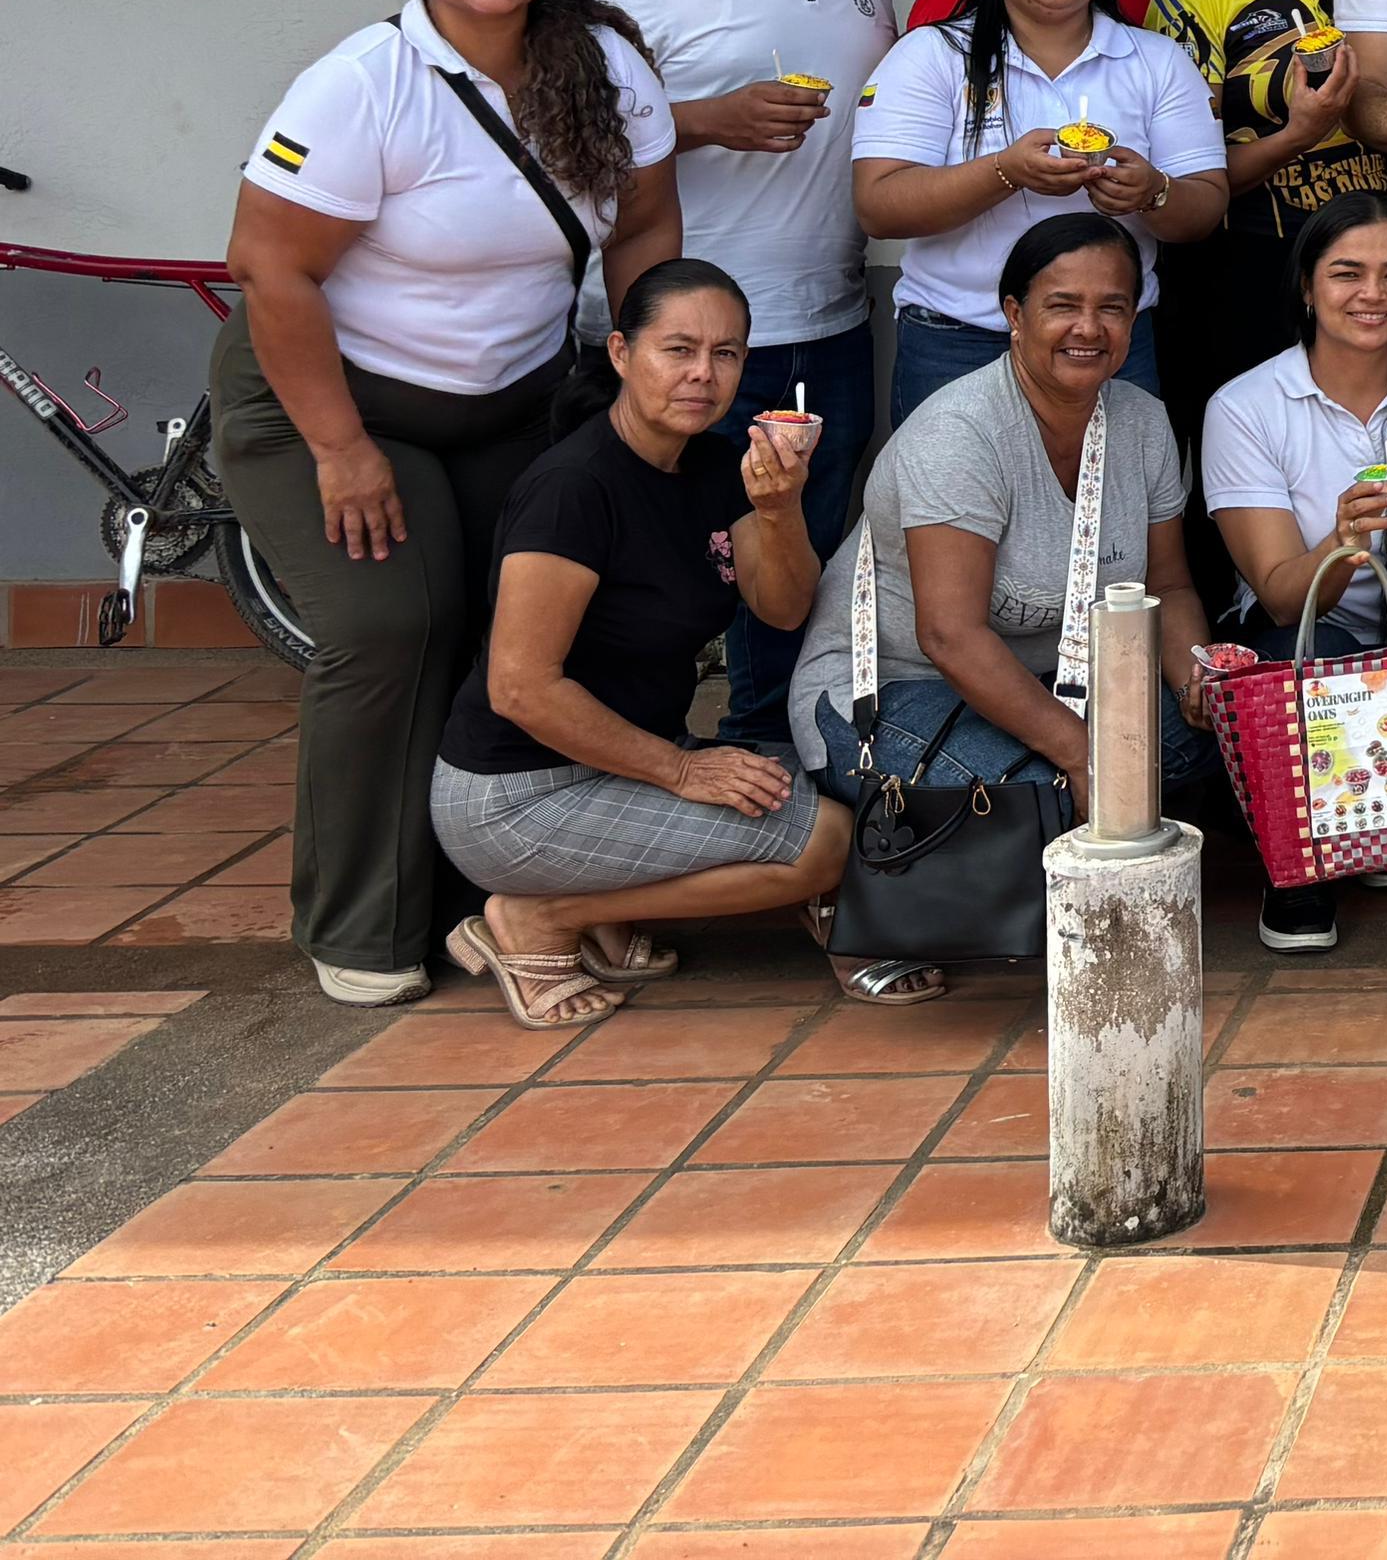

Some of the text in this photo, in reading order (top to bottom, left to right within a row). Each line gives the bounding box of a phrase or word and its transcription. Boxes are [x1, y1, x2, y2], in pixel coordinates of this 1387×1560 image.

[1273, 164, 1303, 186] DE
[1306, 689, 1375, 709] OVERNIGHT
[1308, 708, 1337, 721] OATS
